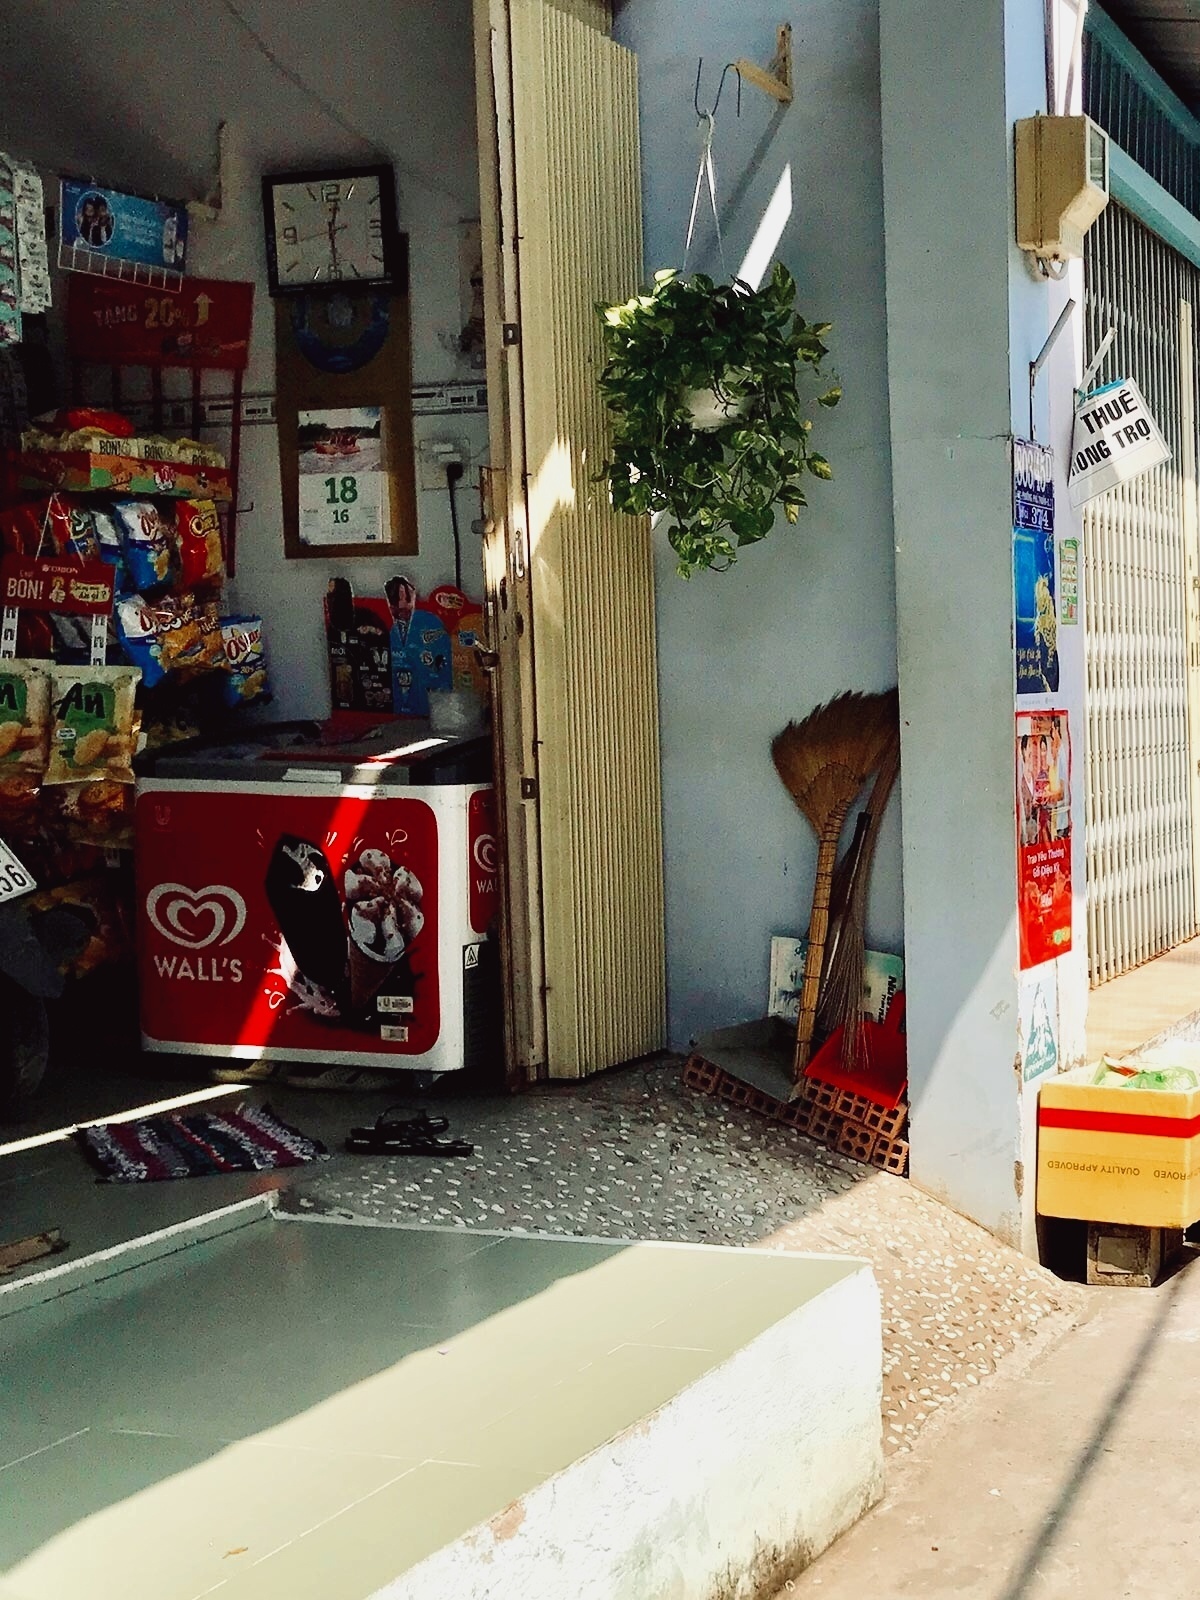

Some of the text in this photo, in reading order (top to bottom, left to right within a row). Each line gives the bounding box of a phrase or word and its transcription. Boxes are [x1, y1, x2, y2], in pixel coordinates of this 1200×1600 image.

[1080, 389, 1138, 434] THUÊ
[1071, 418, 1151, 476] ONG TRỌ
[325, 476, 358, 504] 18
[332, 509, 349, 524] 16
[7, 577, 44, 600] BON!
[154, 955, 244, 983] WALL'S
[1047, 1160, 1140, 1176] QUALITY APPROVED
